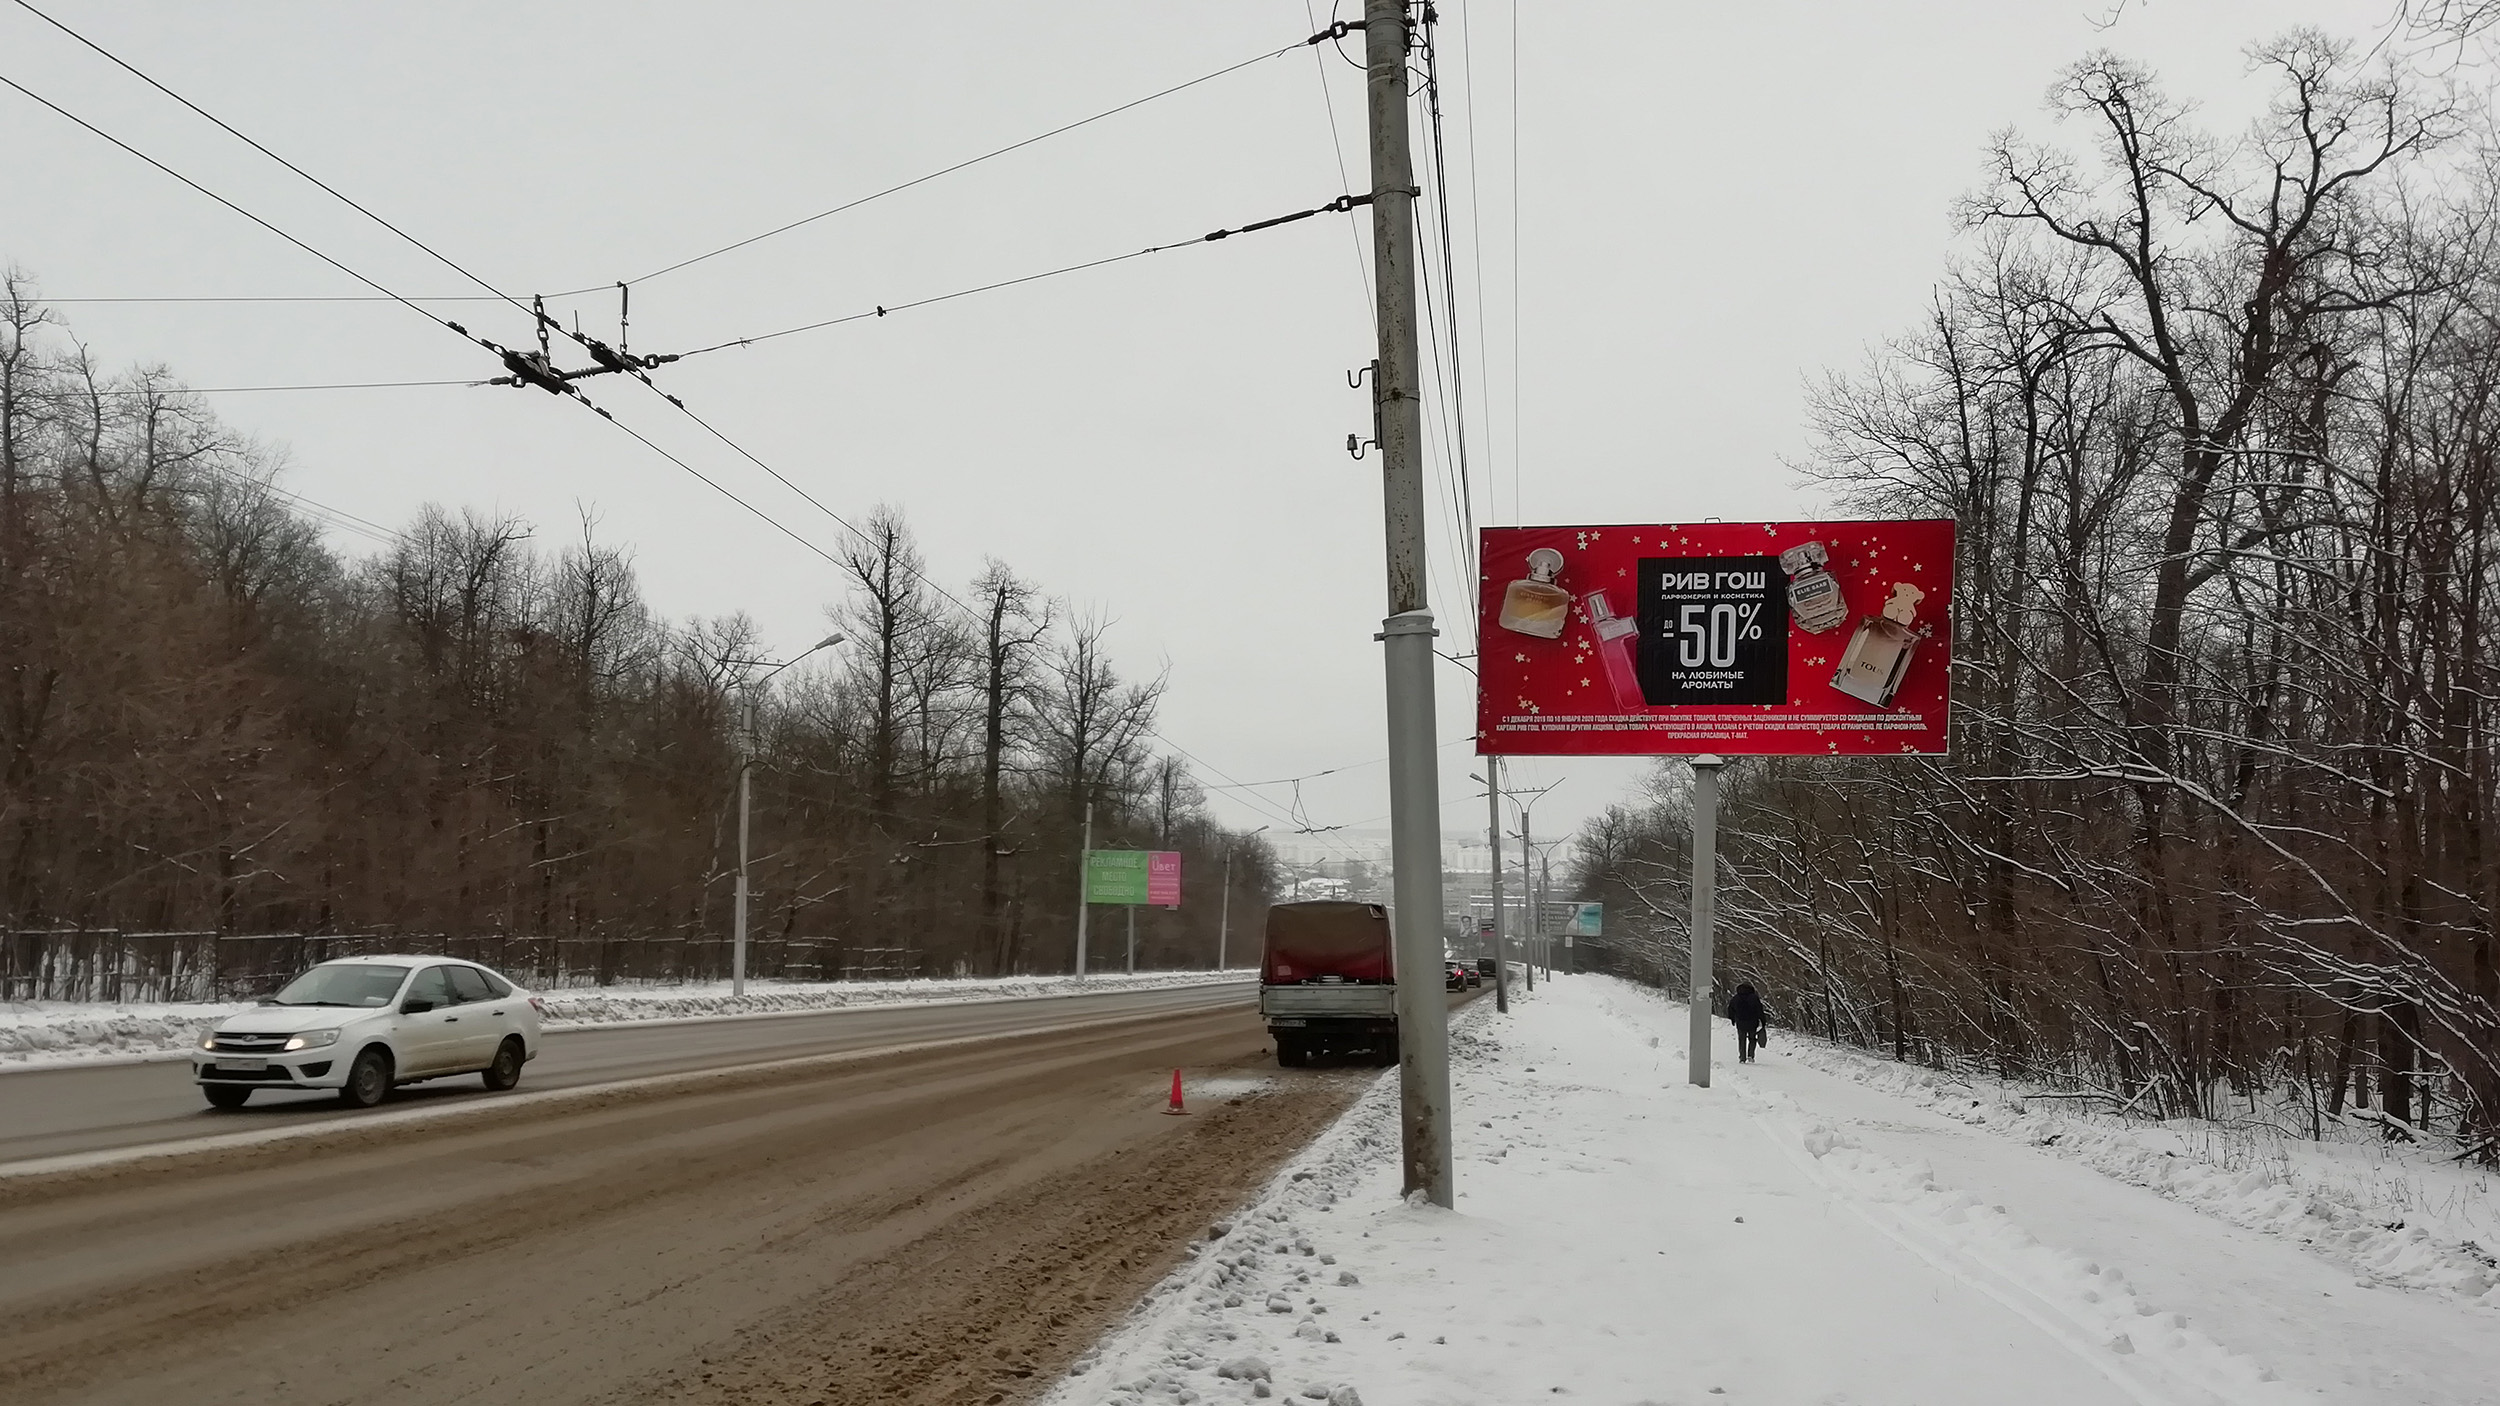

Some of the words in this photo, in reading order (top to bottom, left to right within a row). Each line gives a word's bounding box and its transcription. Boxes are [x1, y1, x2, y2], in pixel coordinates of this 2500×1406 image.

[1662, 573, 1710, 590] РИВ
[1715, 572, 1765, 589] ГОШ
[1796, 587, 1811, 596] ELIE
[1811, 581, 1827, 590] SAAB
[1664, 620, 1673, 629] ДО
[1663, 603, 1762, 668] -50%
[1860, 661, 1884, 675] TOUS
[1672, 671, 1686, 679] НА
[1688, 671, 1745, 680] ЛЮБИМЫЕ
[1681, 681, 1734, 690] АРОМАТЫ
[1511, 715, 1533, 723] ДЕКАБРЯ
[1595, 715, 1608, 723] ГОДА
[1609, 715, 1629, 723] СКИДКА
[1090, 857, 1138, 868] РЕКЛАМНОЕ
[1102, 871, 1127, 882] МЕСТО
[1093, 885, 1135, 897] СВОБОДНО
